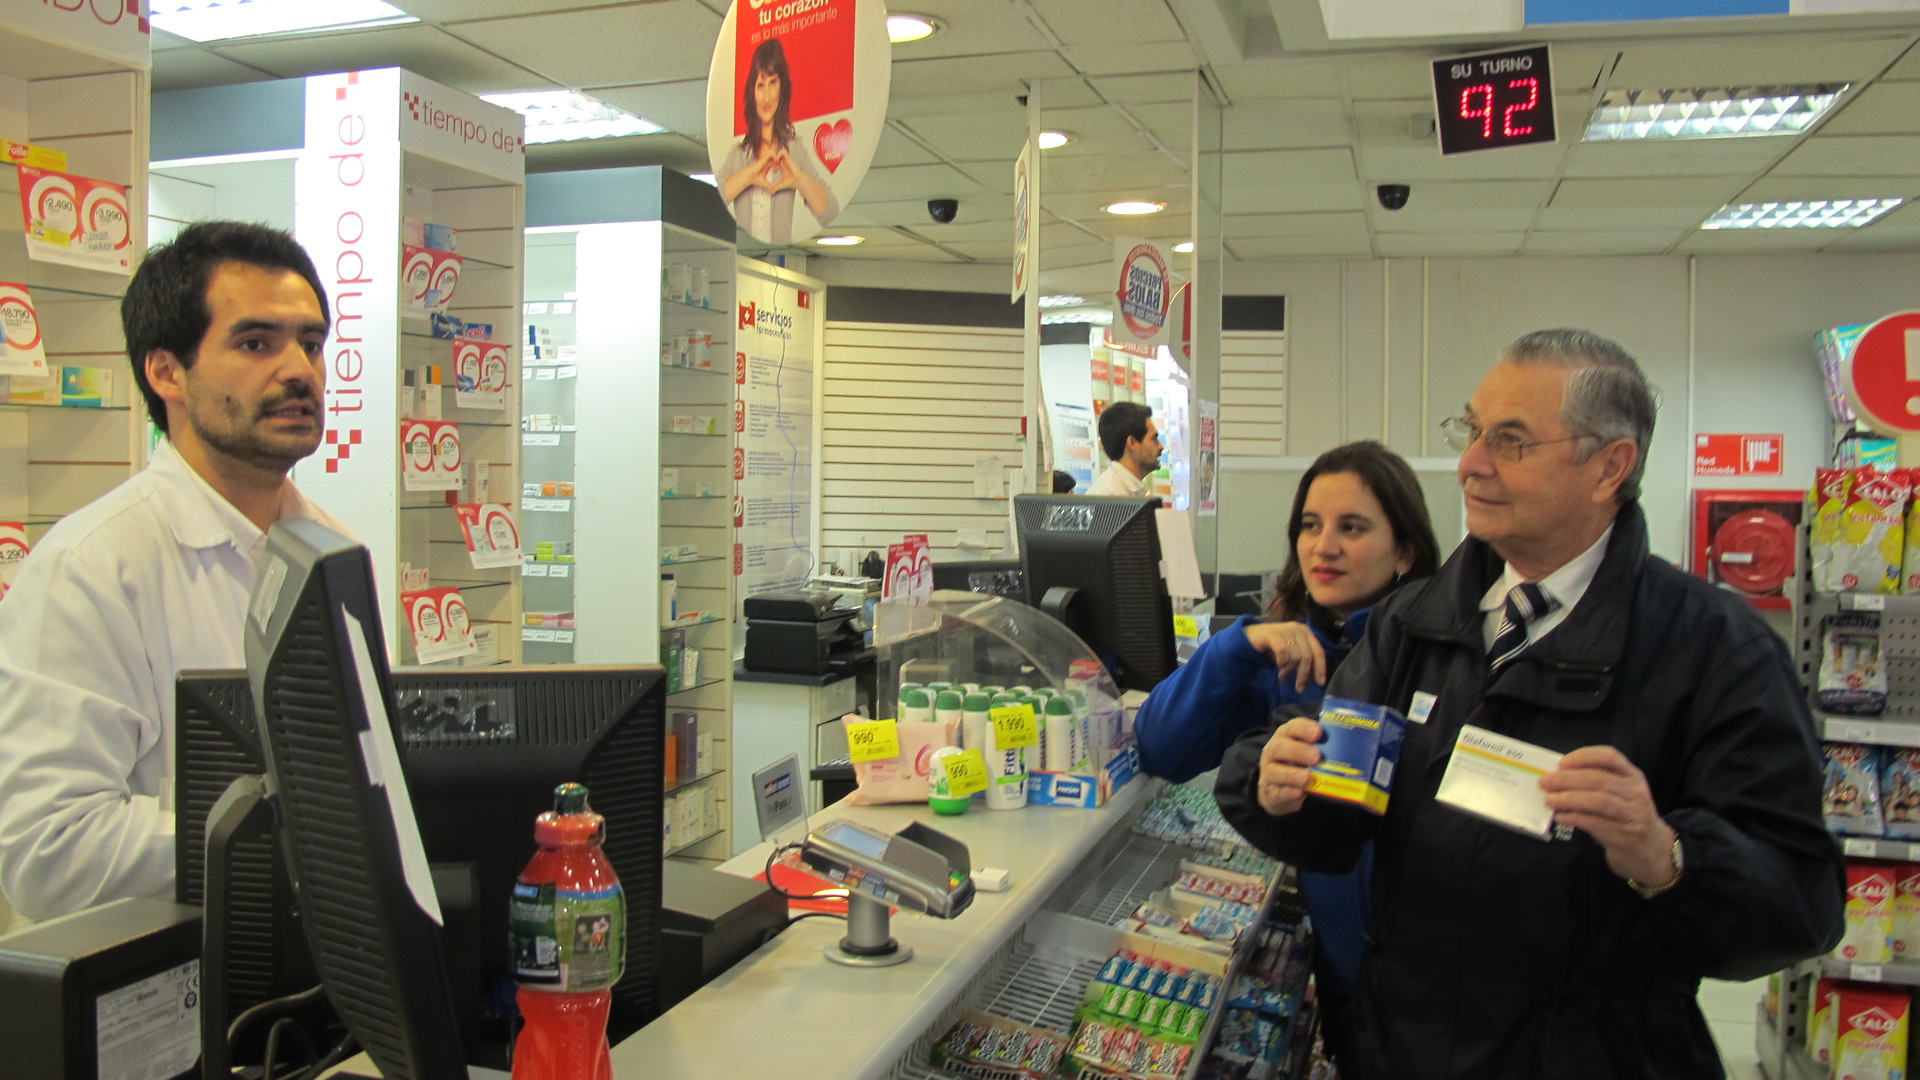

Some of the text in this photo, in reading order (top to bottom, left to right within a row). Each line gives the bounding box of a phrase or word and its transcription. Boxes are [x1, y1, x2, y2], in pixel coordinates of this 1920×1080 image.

[758, 8, 772, 26] tu
[791, 6, 838, 31] importante
[1451, 55, 1533, 80] SU TURNO
[1461, 77, 1538, 138] 92
[423, 101, 514, 154] tiempo de
[325, 114, 374, 417] tiempo de
[757, 308, 793, 328] servicios
[998, 717, 1025, 732] 1.990
[854, 731, 874, 745] 990
[951, 764, 969, 778] 990
[1004, 748, 1016, 776] Fitt
